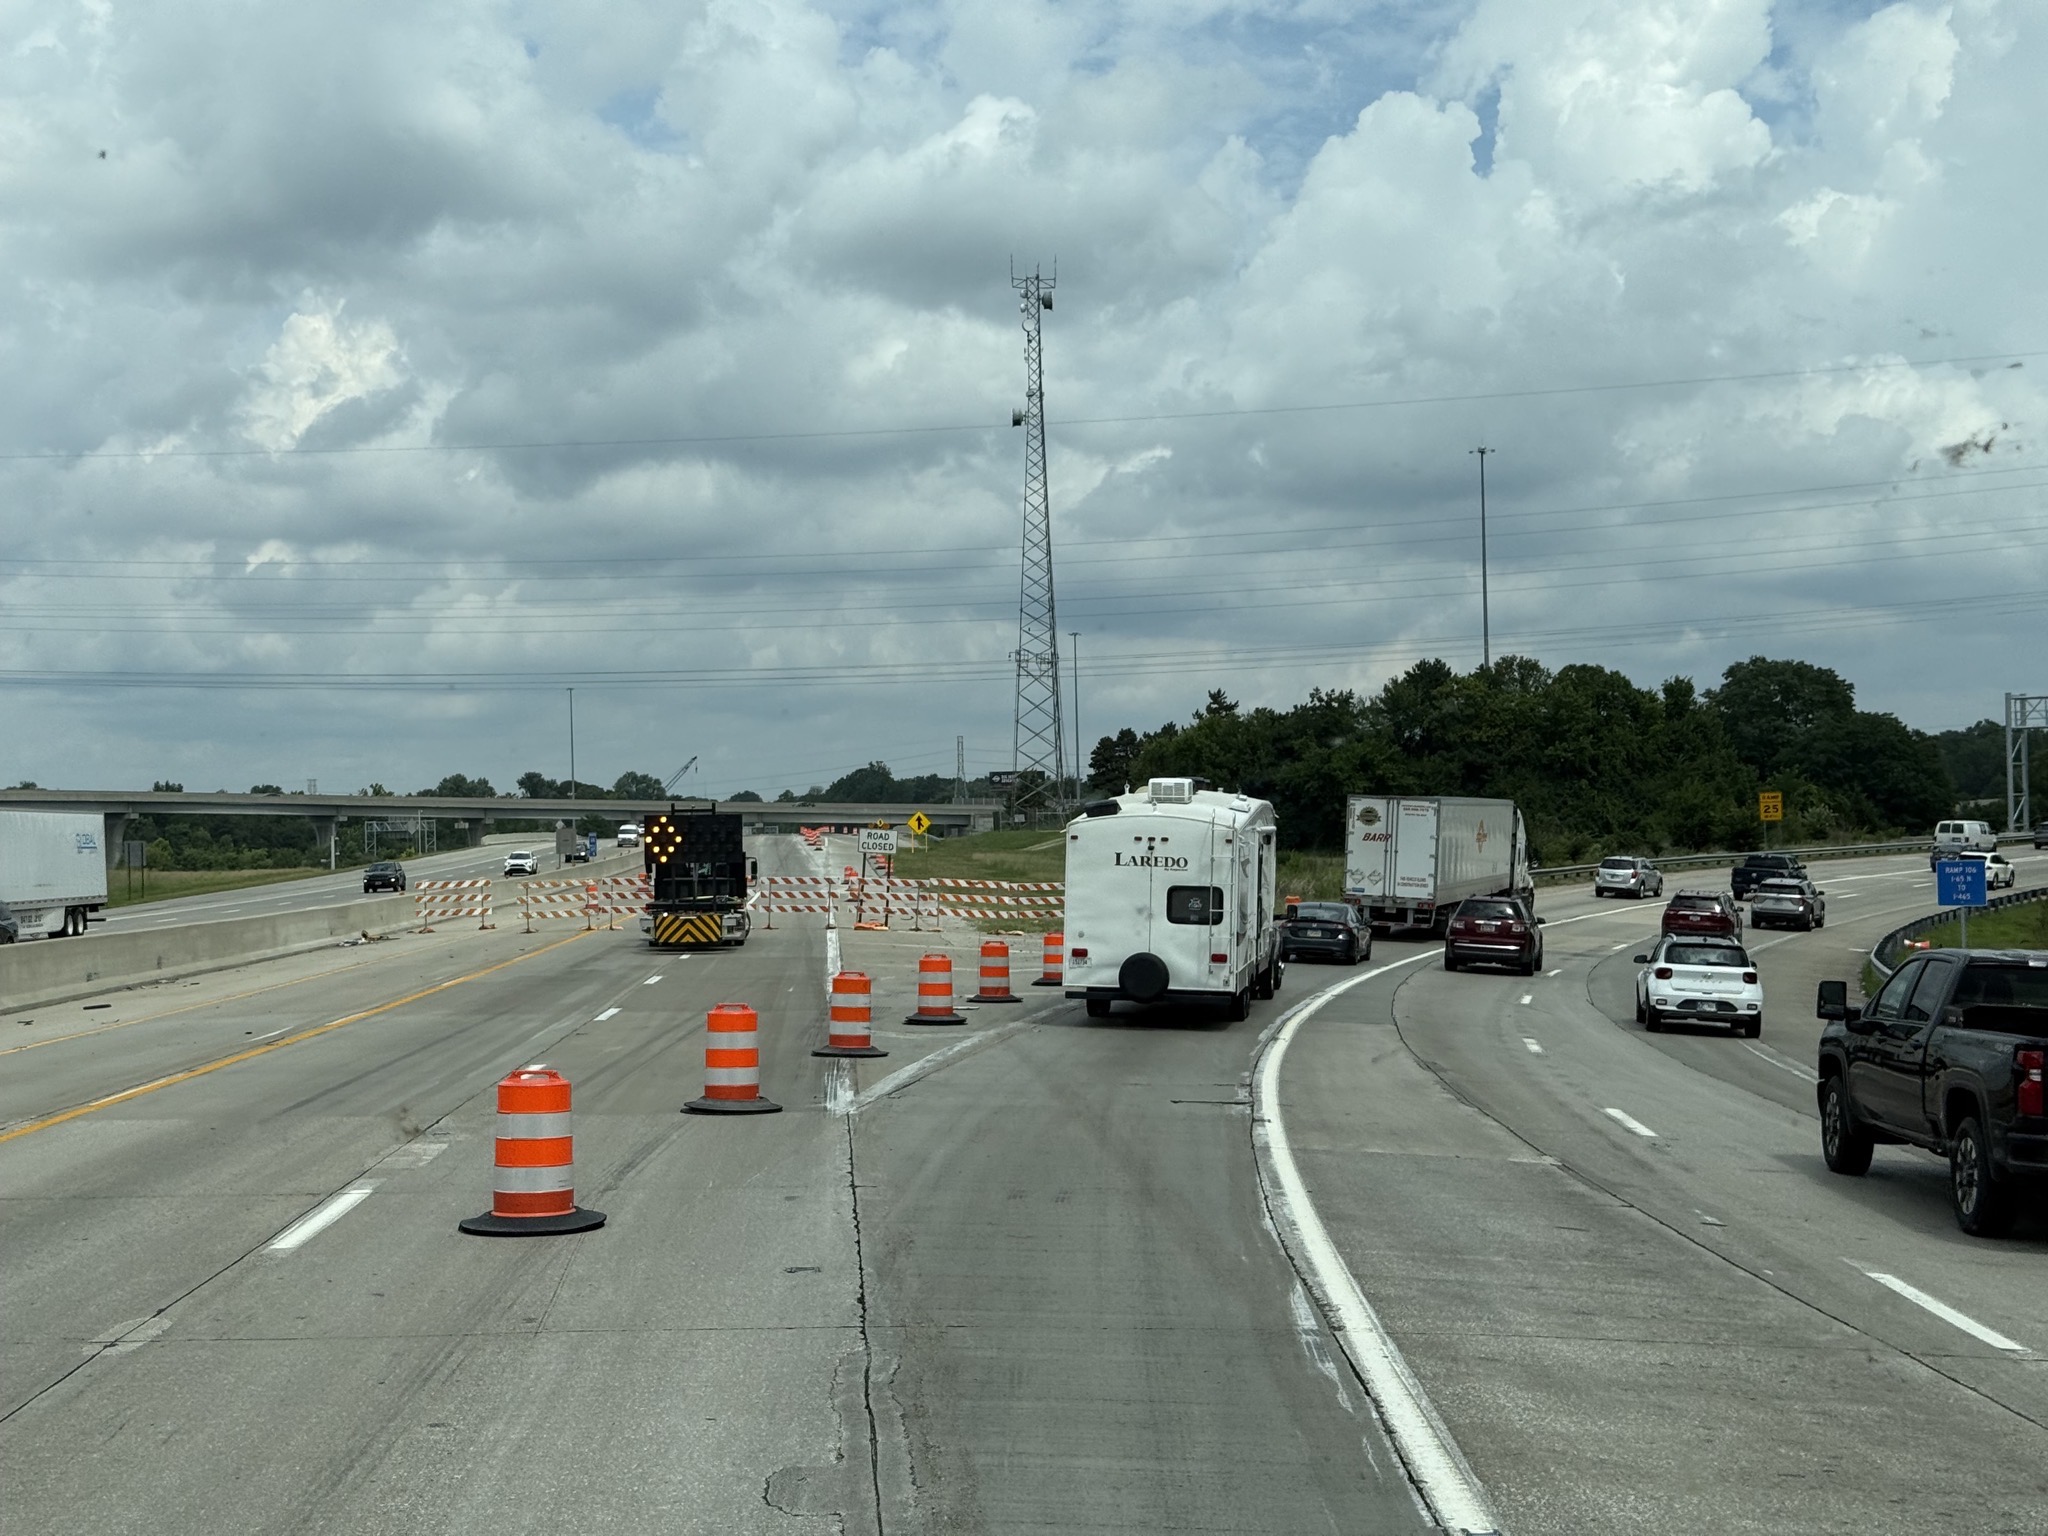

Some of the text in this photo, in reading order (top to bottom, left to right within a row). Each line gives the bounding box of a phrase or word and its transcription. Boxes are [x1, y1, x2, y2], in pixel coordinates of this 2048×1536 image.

[1764, 804, 1779, 814] 25
[867, 831, 890, 841] ROAD
[1362, 832, 1392, 842] BARR
[861, 841, 894, 851] CLOSED
[1945, 866, 1977, 874] RAMP 106
